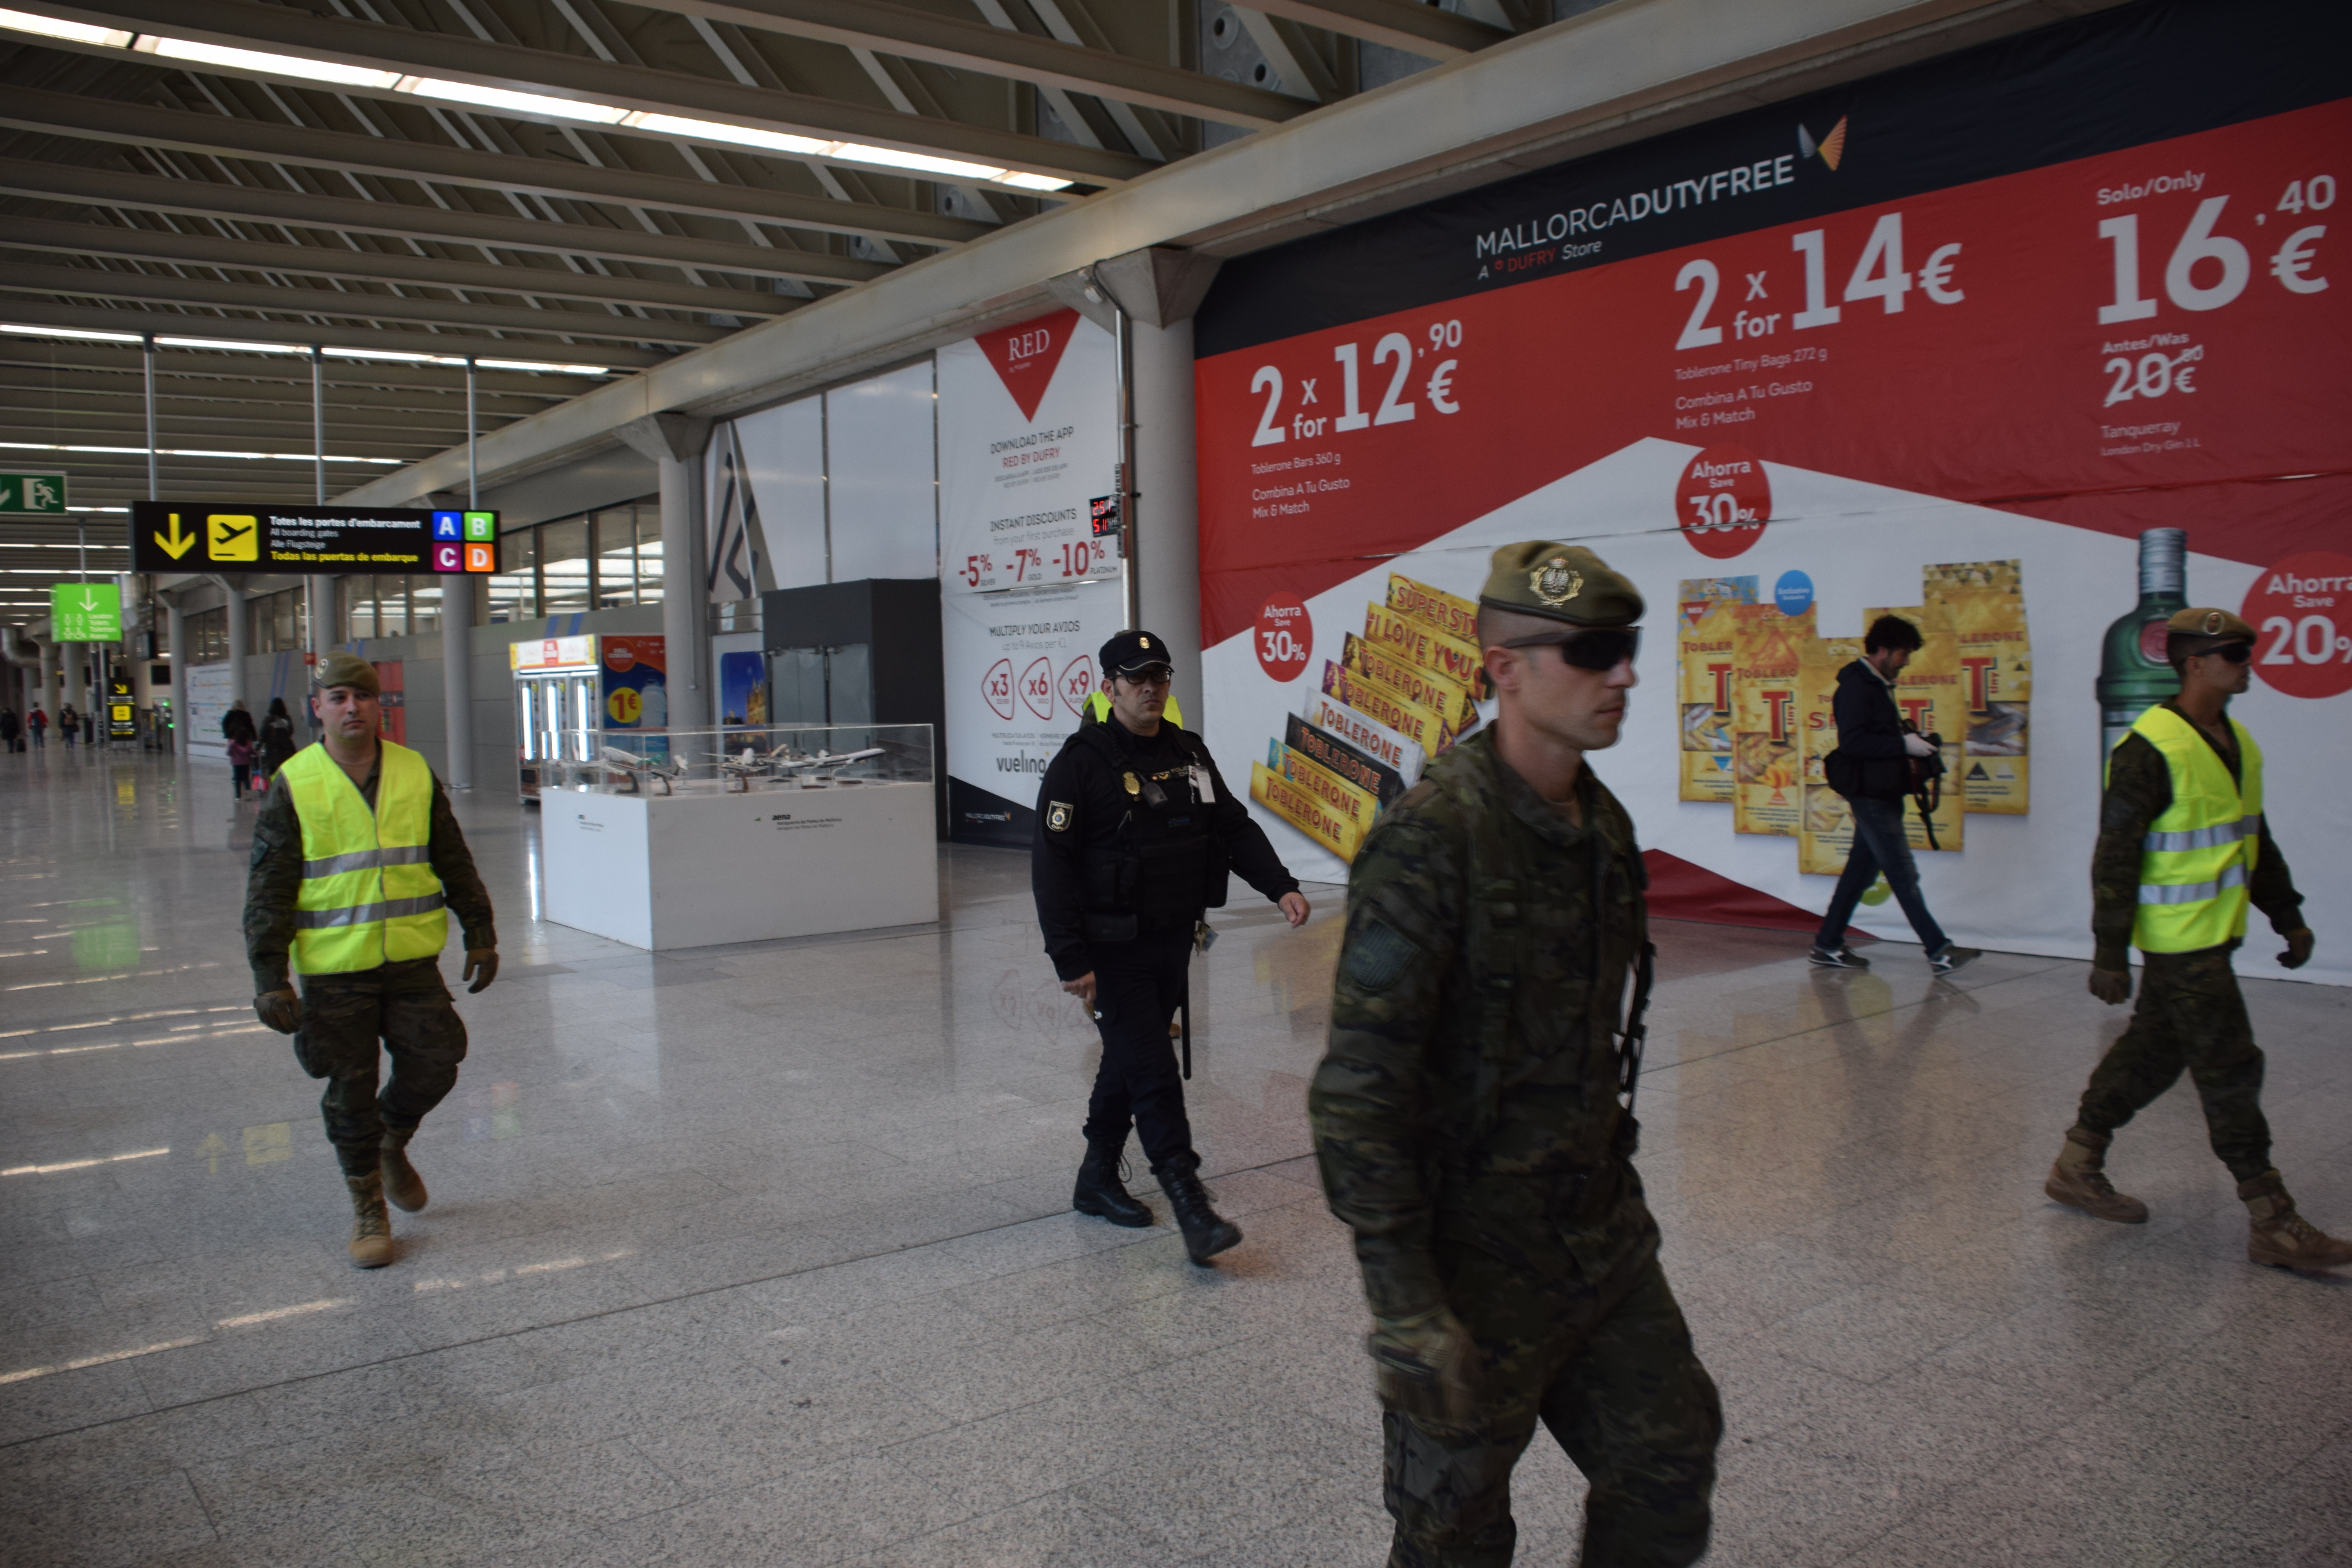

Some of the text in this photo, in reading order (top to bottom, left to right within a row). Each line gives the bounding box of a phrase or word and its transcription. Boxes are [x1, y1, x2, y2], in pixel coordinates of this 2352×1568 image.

[2097, 170, 2206, 205] Solo/Only
[1475, 154, 1795, 259] MALLORCADUTYFREE
[1507, 248, 1556, 273] DUFRY
[1562, 240, 1602, 260] Store
[1674, 258, 1723, 351] 2
[1733, 310, 1781, 340] for
[1008, 328, 1051, 361] RED
[2102, 332, 2190, 354] Antes/Was
[1674, 346, 1828, 381] Toblerone Tiny Bags 272 g
[1250, 365, 1286, 447] 2
[1293, 413, 1327, 440] for
[1675, 380, 1813, 410] Combina A Tu Gusto
[1675, 406, 1756, 430] Mix & Match
[991, 426, 1074, 454] DOWNLOAD THE APP
[2101, 421, 2181, 439] Tanqueray
[1002, 447, 1060, 468] RED BY DUFRY
[1251, 452, 1341, 475] Toblerone Bars 360 g
[1691, 461, 1752, 479] Ahorra
[1252, 478, 1351, 501] Combina A Tu Gusto
[1709, 477, 1735, 489] Save
[990, 508, 1077, 532] INSTANT DISCOUNTS
[1252, 500, 1310, 519] Mix & Match
[1689, 493, 1760, 534] 30%
[269, 516, 422, 529] Totes les portes d'embarcament
[281, 528, 315, 538] boarding
[316, 529, 339, 538] gates
[439, 517, 486, 536] A B
[270, 539, 326, 550] Alle Flugsteige
[993, 528, 1074, 546] from your first purchase
[270, 551, 301, 560] Todas
[302, 552, 317, 561] las
[318, 553, 355, 562] puertas
[370, 553, 419, 563] embarque
[439, 547, 488, 567] C D
[959, 540, 1105, 587] -5% -7% -10%
[1090, 566, 1118, 575] PLATINUM
[1264, 604, 1302, 619] Ahorra
[2293, 595, 2335, 608] Save
[989, 621, 1080, 637] MULTIPLY YOUR AVIOS
[1274, 618, 1291, 627] Save
[1002, 643, 1011, 652] up
[1026, 641, 1044, 649] Avios
[1045, 641, 1056, 651] per
[1261, 630, 1307, 662] 30%
[1383, 618, 1428, 660] LOVE
[1682, 641, 1733, 655] TOBLER
[991, 673, 1009, 696] x3
[1028, 672, 1049, 696] x6
[1069, 670, 1090, 695] x9
[1359, 646, 1448, 714] TOBLERONE
[1735, 668, 1798, 681] TOBLERO
[1340, 674, 1424, 742] TOBLERONE
[1320, 701, 1403, 768] TOBLERONE
[996, 749, 1047, 781] vueling
[1301, 726, 1381, 795] TOBLERONE
[1283, 752, 1361, 821] TOBLERONE
[1265, 776, 1342, 844] TOBLERONE
